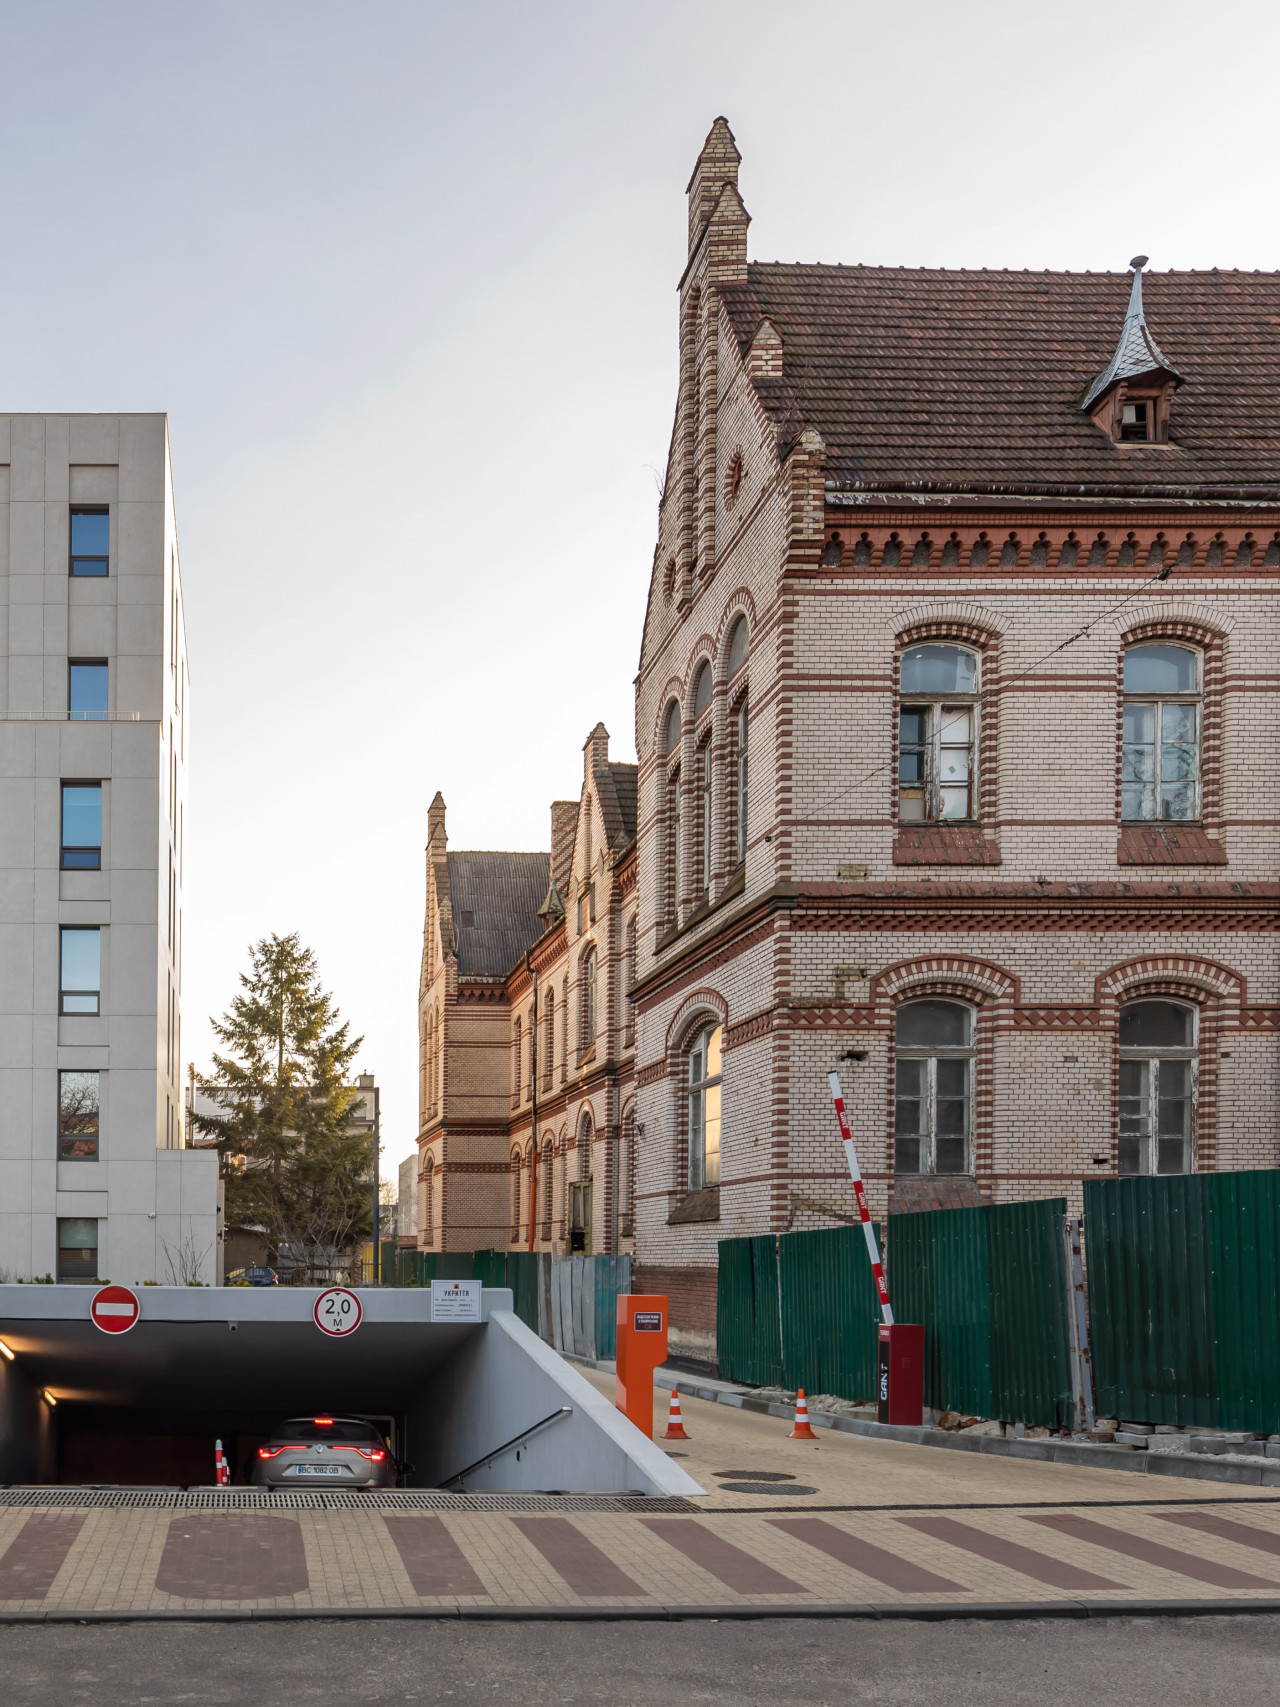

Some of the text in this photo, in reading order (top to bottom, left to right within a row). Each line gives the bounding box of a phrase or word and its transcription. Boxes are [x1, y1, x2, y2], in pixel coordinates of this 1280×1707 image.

[839, 1111, 848, 1129] GANT
[858, 1192, 867, 1210] GANT
[878, 1276, 886, 1294] GANT
[325, 1299, 351, 1317] 2,0
[880, 1363, 888, 1400] GANT
